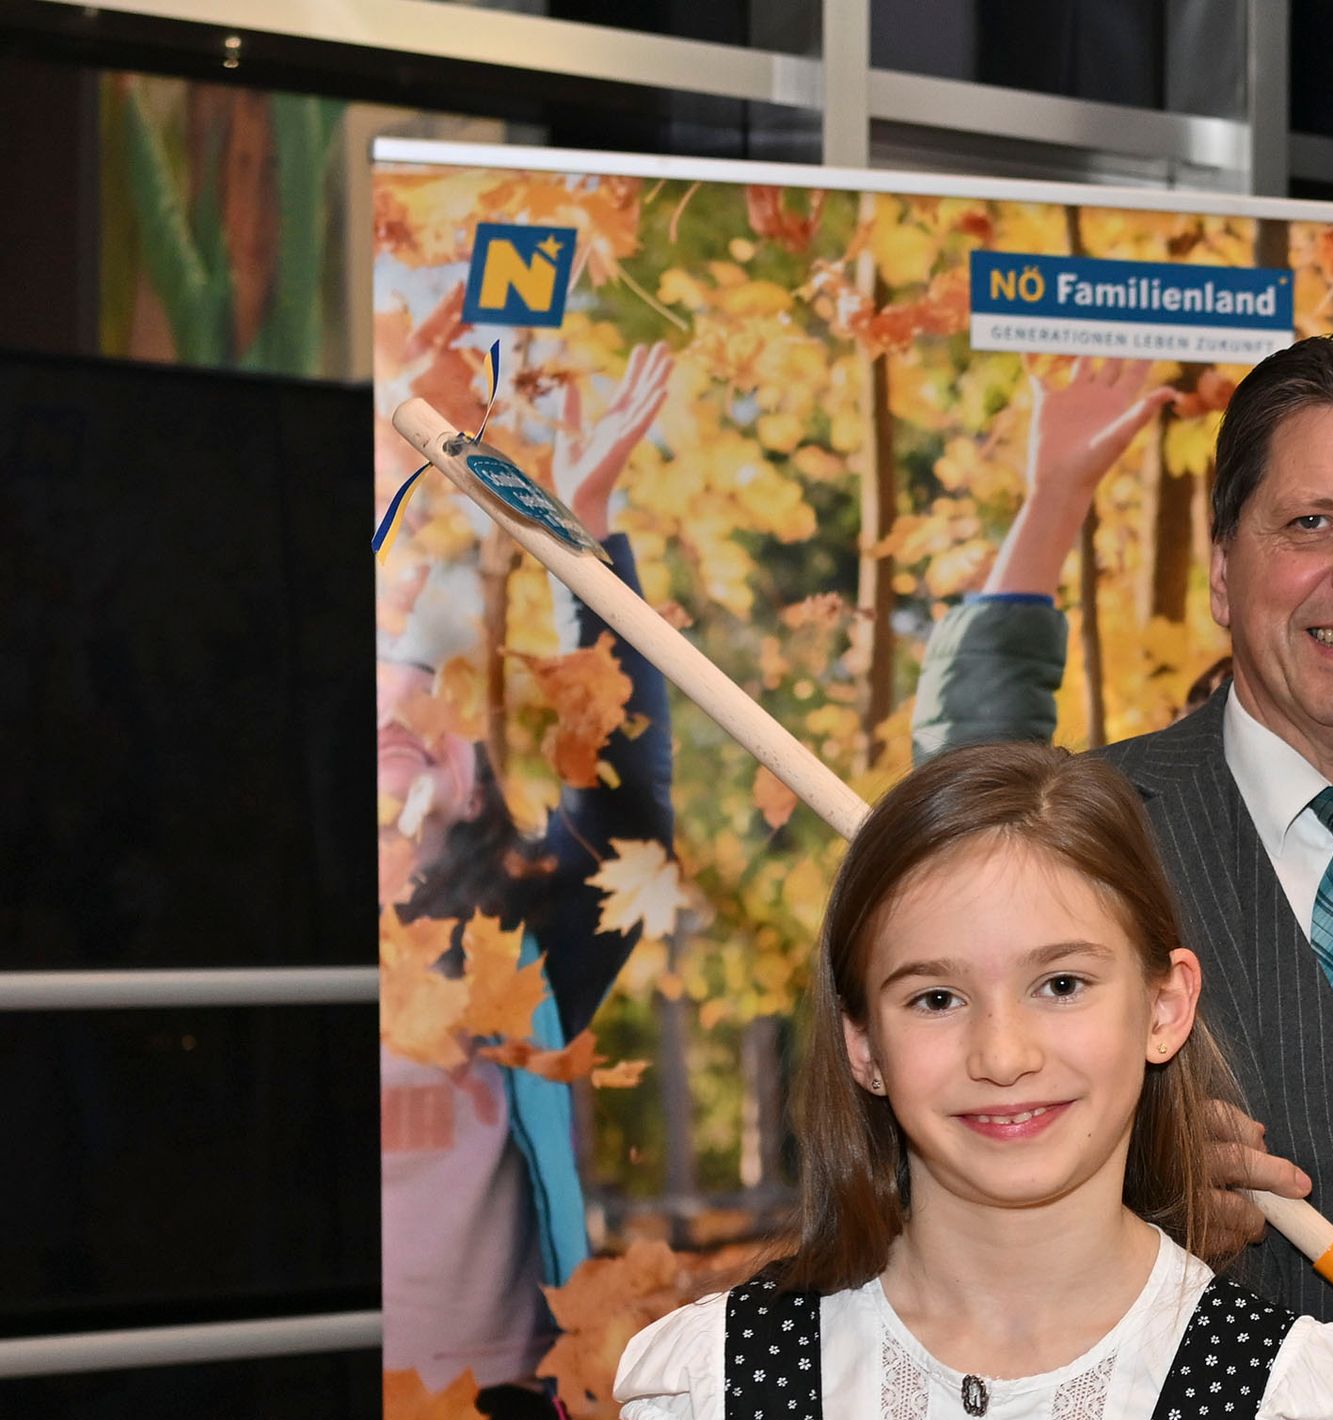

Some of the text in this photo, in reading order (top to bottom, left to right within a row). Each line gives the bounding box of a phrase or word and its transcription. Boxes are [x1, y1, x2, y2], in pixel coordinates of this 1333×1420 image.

[479, 238, 557, 313] N
[990, 266, 1276, 316] NÖ Familienland
[990, 325, 1274, 353] GENERATIONEN LEBEN ZUKUNFT
